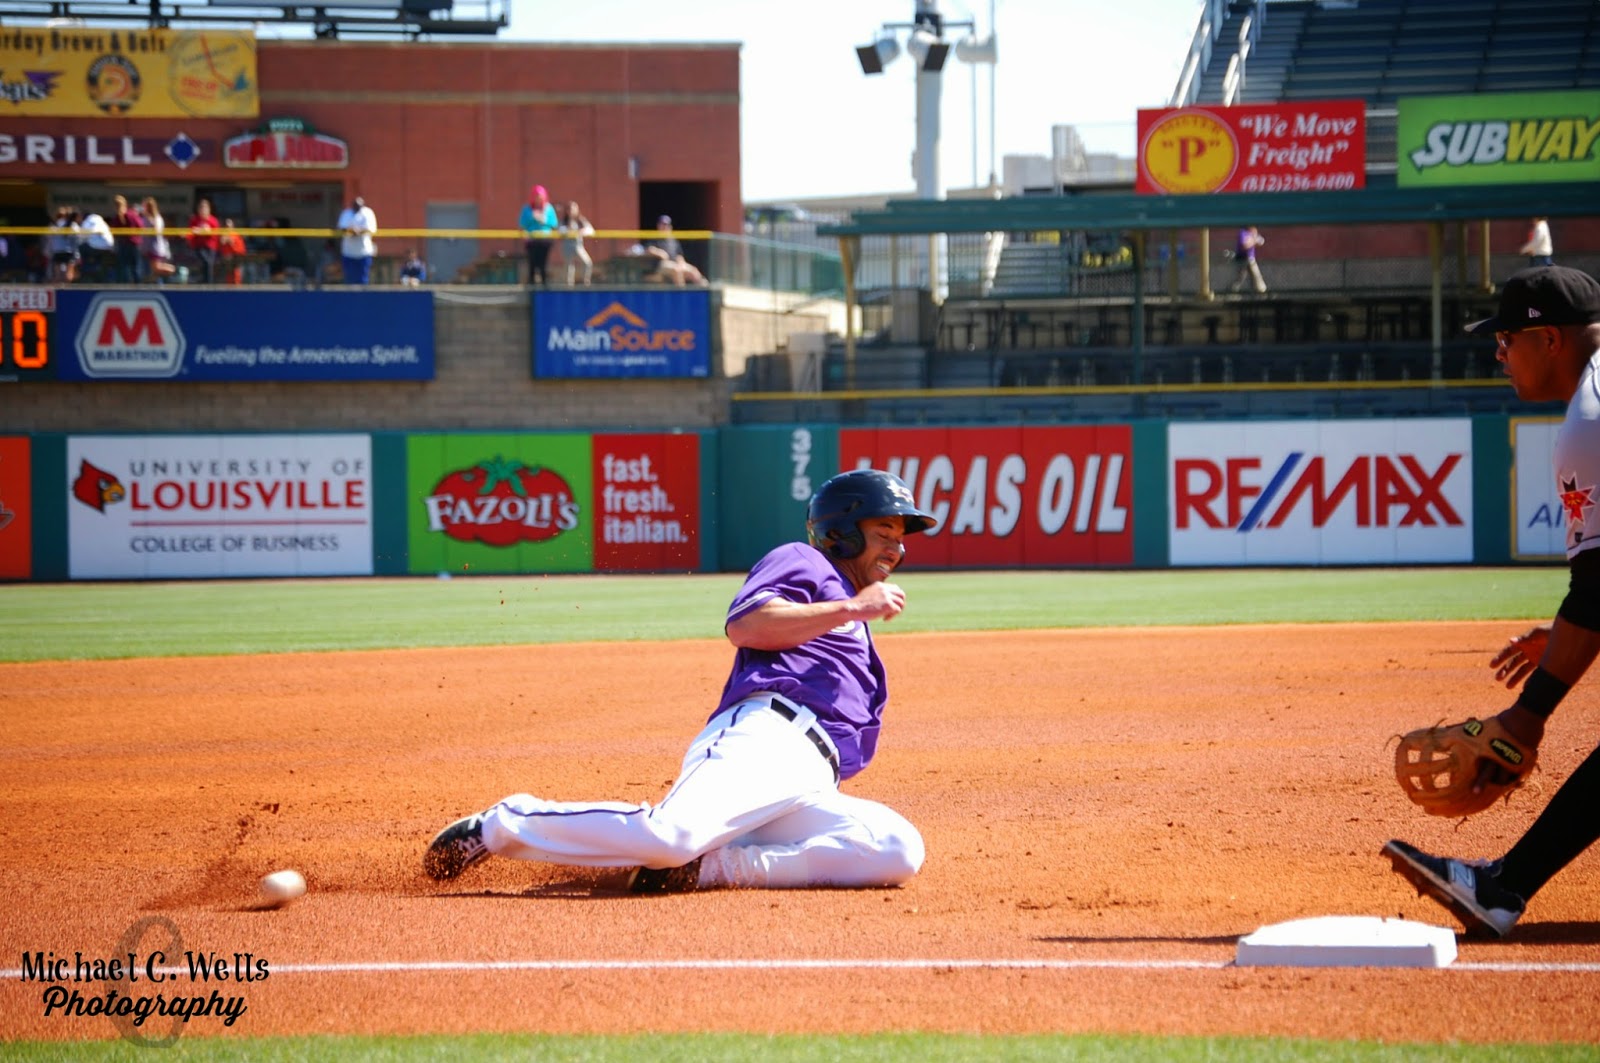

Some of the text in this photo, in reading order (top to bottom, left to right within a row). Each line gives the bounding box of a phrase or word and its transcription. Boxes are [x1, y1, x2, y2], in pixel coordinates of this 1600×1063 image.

[1293, 112, 1357, 137] Move
[0, 135, 151, 164] GRILL
[1411, 118, 1600, 168] SUBWAY
[548, 325, 695, 351] MainSource
[195, 345, 419, 366] Fueling the American Spirit.
[129, 458, 364, 477] UNIVERSITY OF
[603, 453, 658, 482] fast.
[129, 480, 365, 511] LOUISVILLE
[603, 485, 675, 513] fresh.
[854, 453, 1128, 537] CAS OIL
[1174, 452, 1464, 533] RE/MAX
[129, 534, 339, 553] COLLEGE OF BUSINESS
[603, 518, 689, 544] italian.
